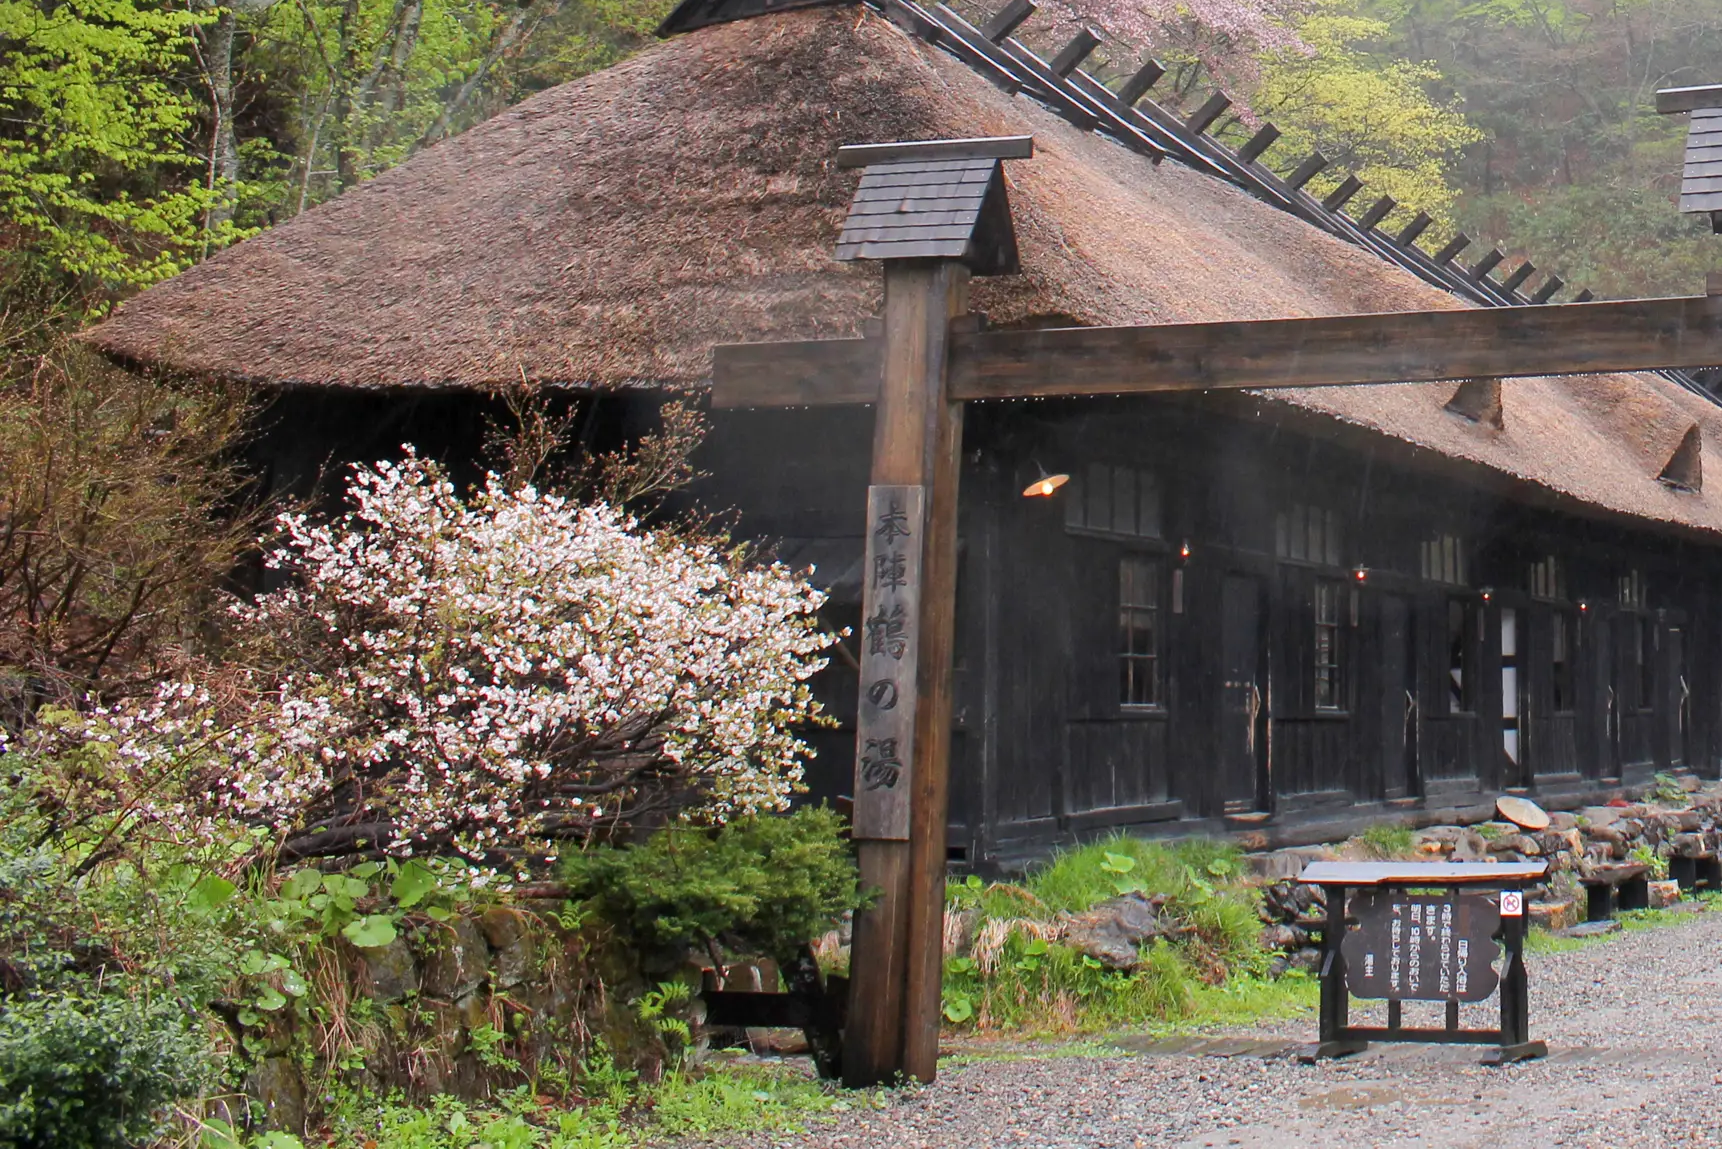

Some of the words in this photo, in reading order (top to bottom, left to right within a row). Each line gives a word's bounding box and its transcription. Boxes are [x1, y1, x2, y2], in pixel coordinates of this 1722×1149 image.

[861, 501, 911, 791] 本陣鶴の湯
[1426, 904, 1436, 941] きます。
[1456, 940, 1468, 992] 日帰り入浴は
